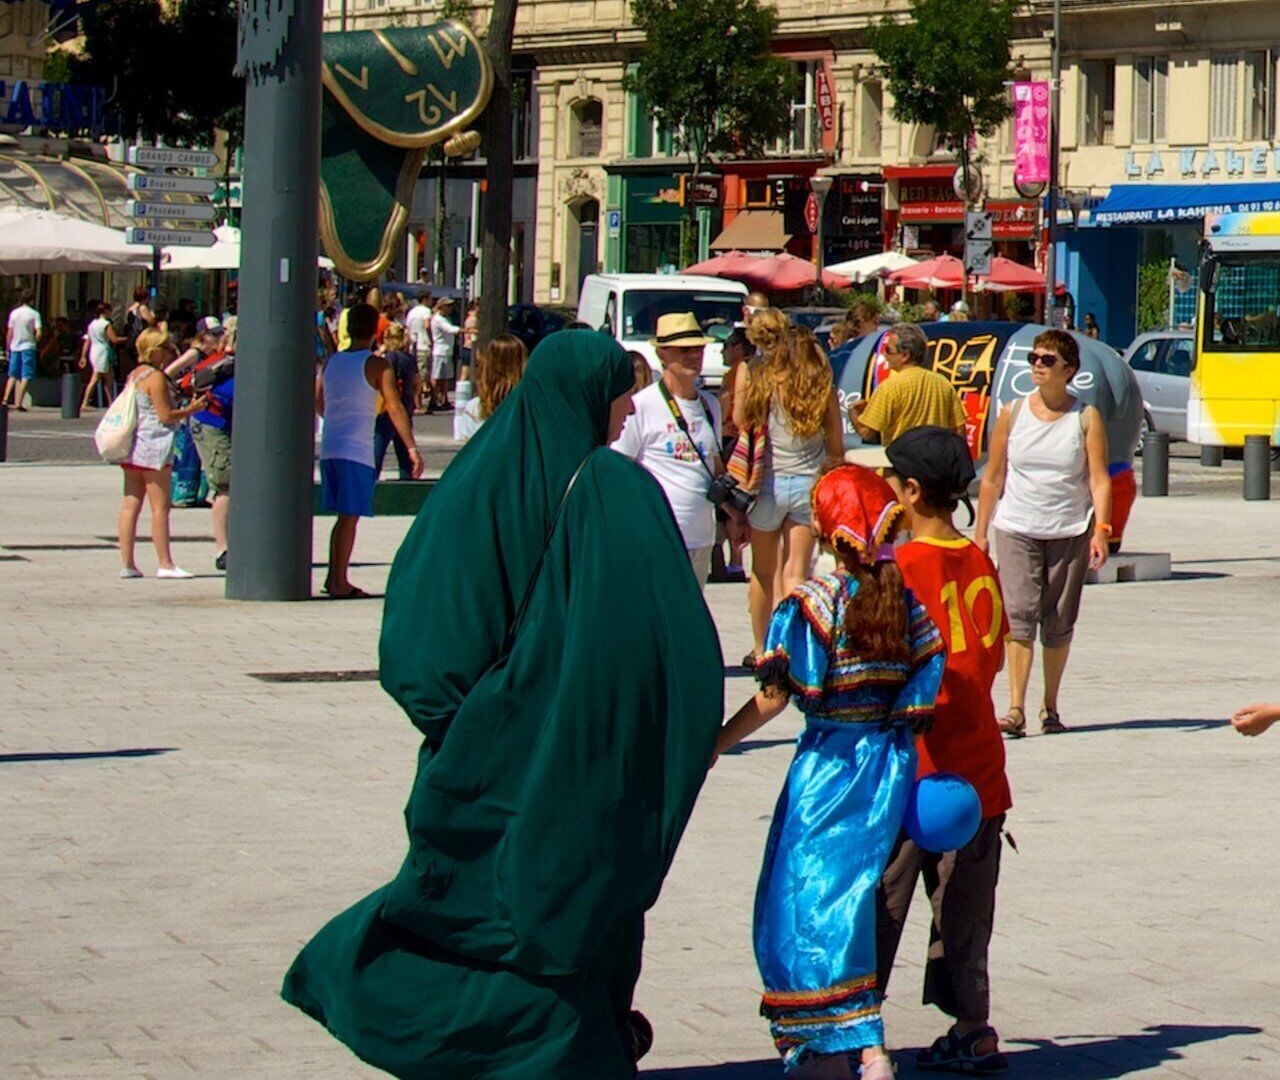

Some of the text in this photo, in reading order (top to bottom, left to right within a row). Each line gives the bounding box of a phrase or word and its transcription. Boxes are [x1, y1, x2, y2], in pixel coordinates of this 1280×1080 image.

[818, 72, 833, 129] TABAC
[1096, 209, 1154, 222] RESTAURANT
[1157, 207, 1175, 219] LA
[940, 575, 1003, 654] 10
